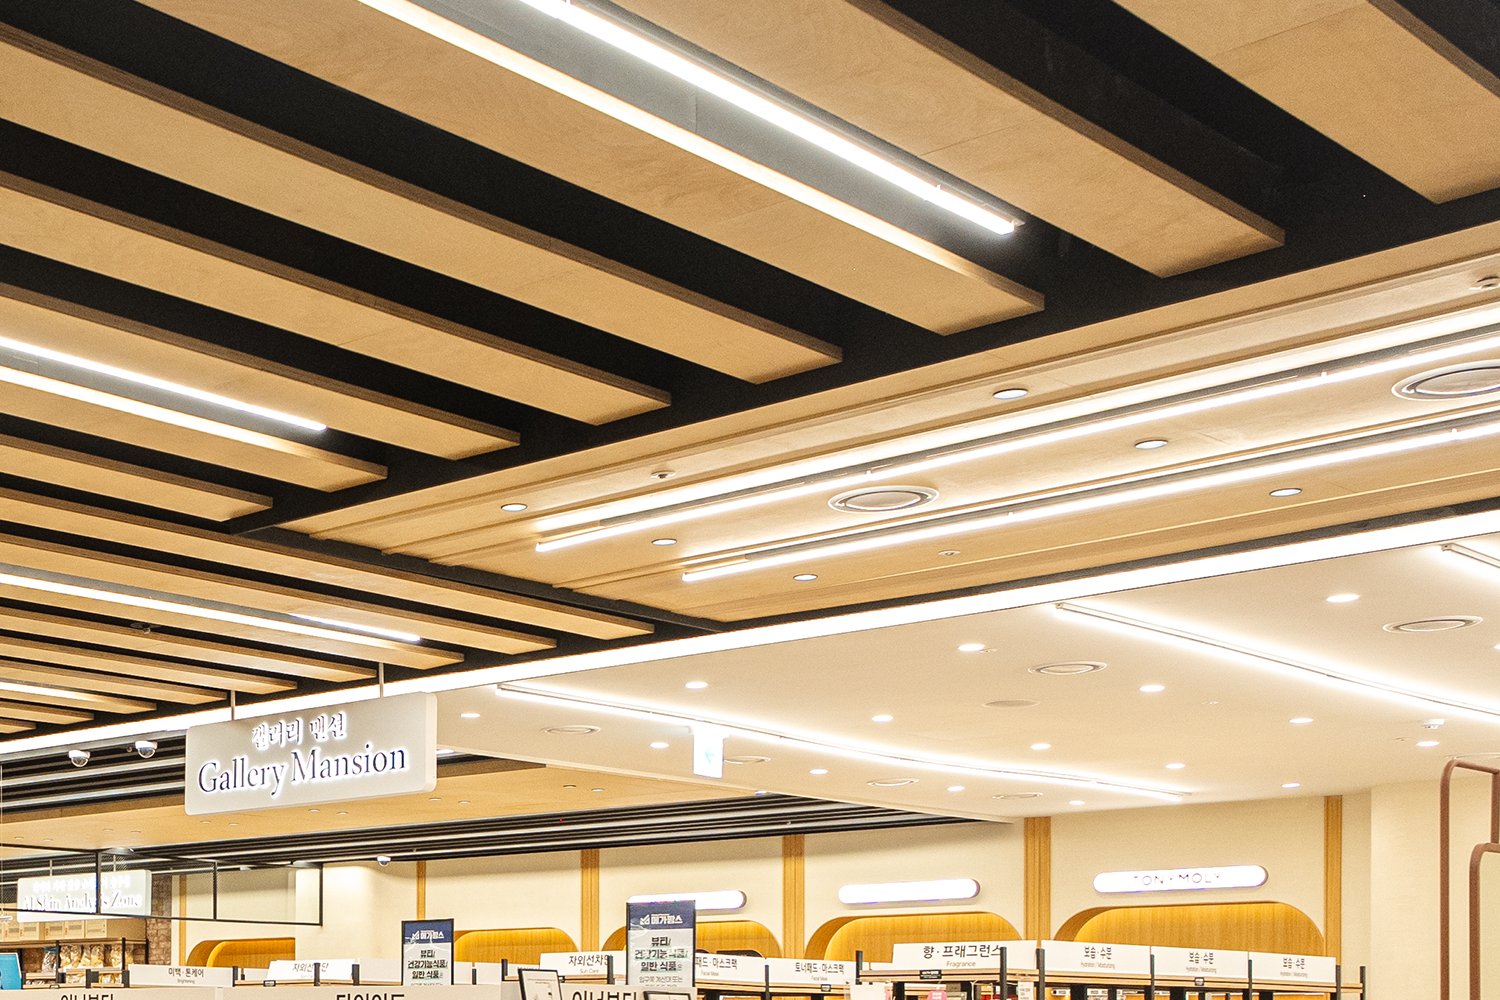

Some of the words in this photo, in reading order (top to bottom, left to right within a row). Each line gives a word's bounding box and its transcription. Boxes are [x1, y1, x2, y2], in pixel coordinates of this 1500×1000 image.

[252, 718, 301, 749] 갤러리
[309, 712, 346, 741] 맨션
[198, 757, 285, 796] Gallery
[290, 743, 406, 783] Mansion
[1133, 872, 1221, 886] TONYMOLY
[640, 961, 658, 972] 일반
[946, 960, 976, 968] Fragrance
